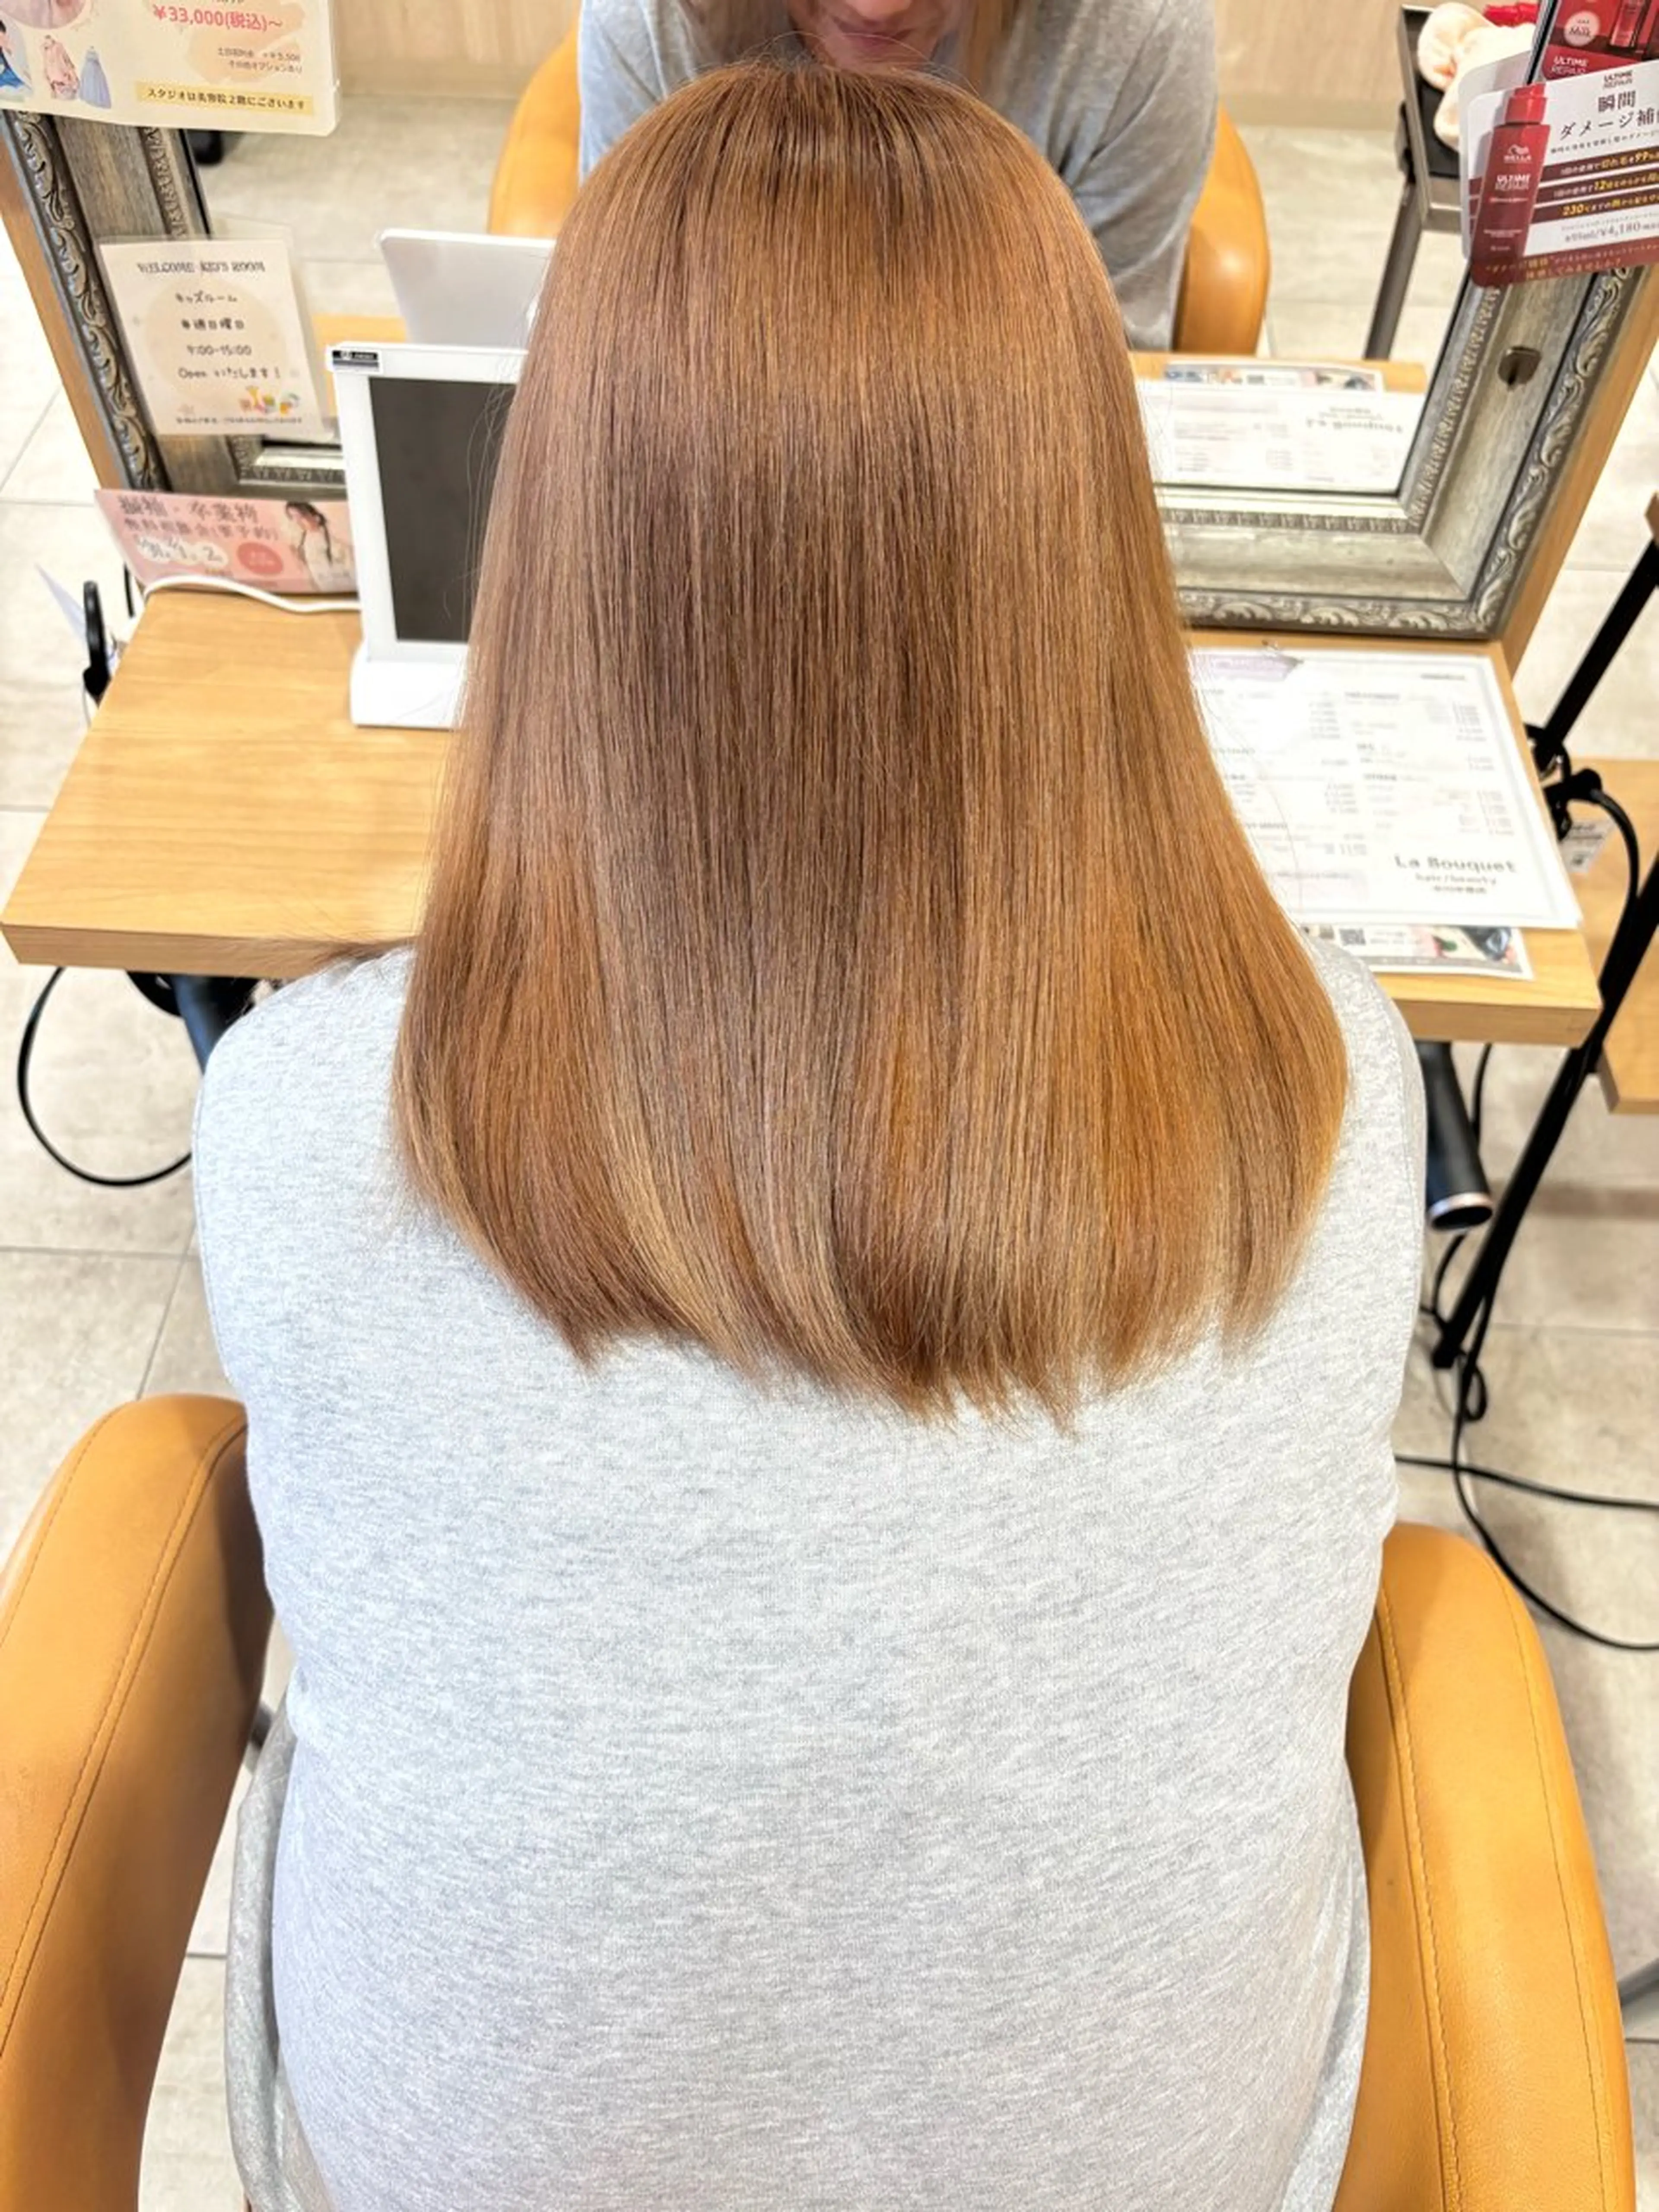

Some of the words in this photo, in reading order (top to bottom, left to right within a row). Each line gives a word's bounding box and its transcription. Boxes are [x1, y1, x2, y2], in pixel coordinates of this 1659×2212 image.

[1598, 90, 1636, 112] 瞬間
[1560, 108, 1659, 141] ダメージ補
[137, 261, 195, 273] WELCOME
[231, 261, 266, 273] ROOM
[175, 289, 238, 303] キッズルーム
[181, 317, 245, 331] 毎週日曜日
[178, 367, 207, 379] Open
[1395, 855, 1421, 869] La
[1427, 856, 1516, 874] Bouquet
